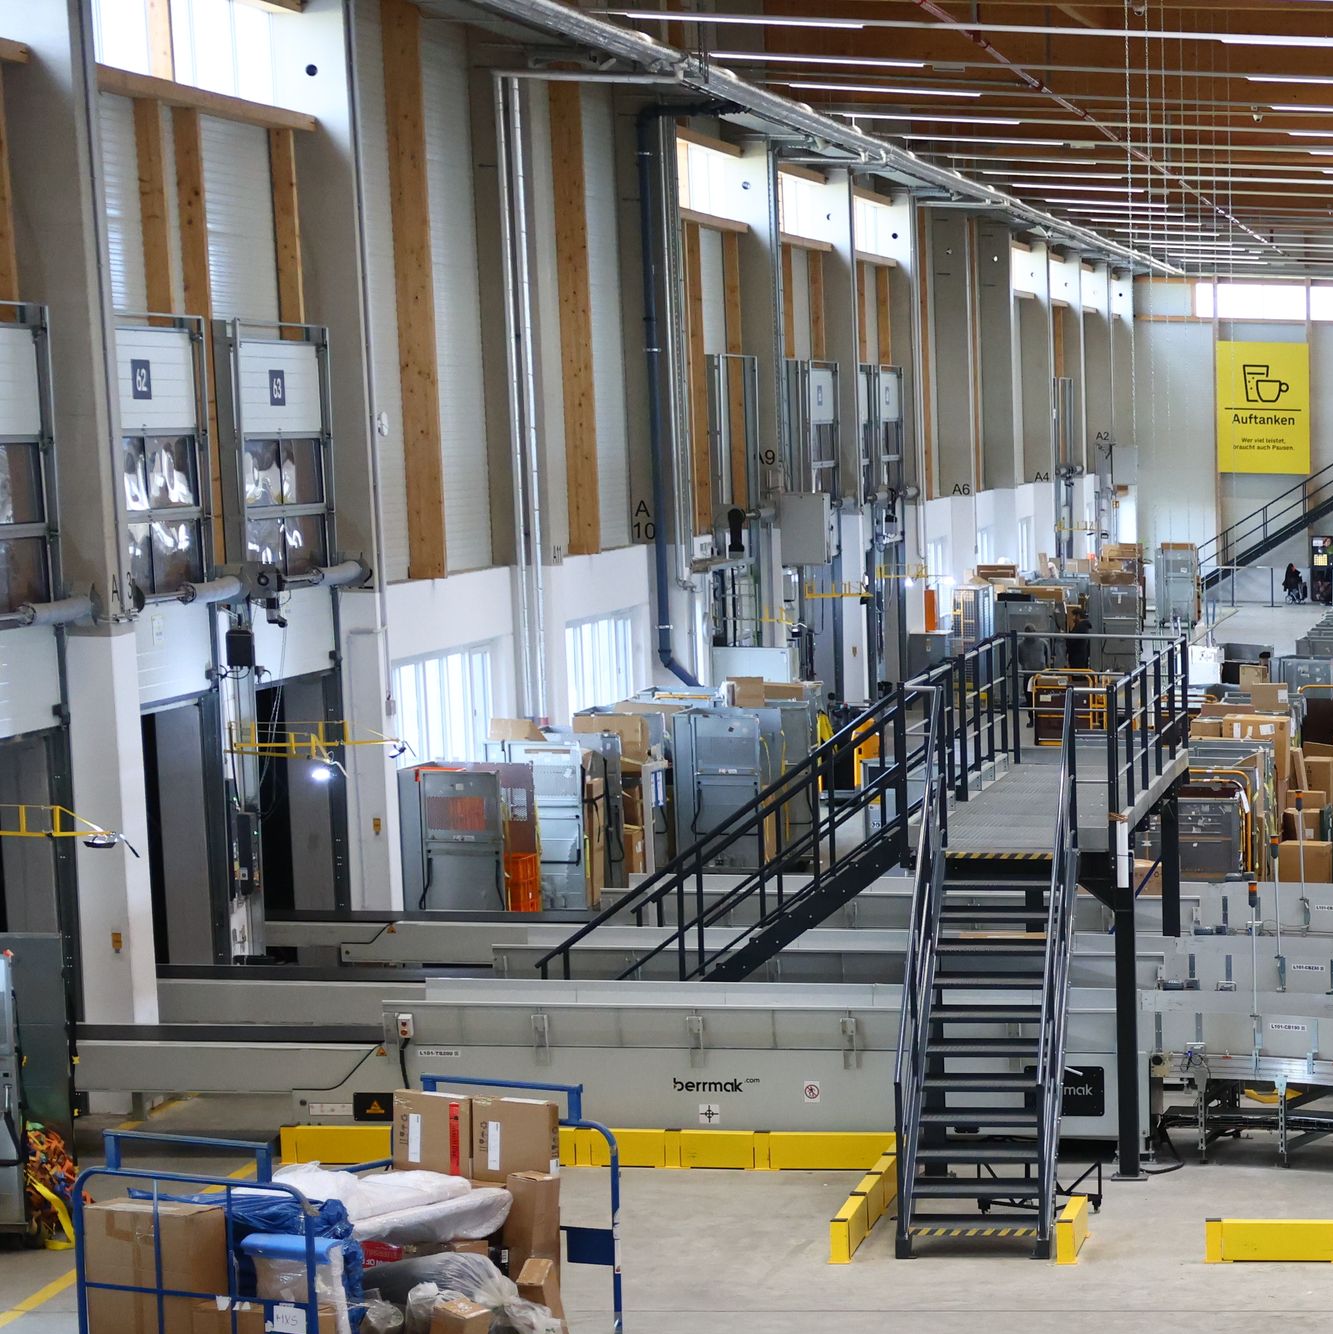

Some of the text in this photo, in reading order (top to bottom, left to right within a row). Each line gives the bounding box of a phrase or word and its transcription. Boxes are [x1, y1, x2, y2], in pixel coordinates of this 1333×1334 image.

[135, 368, 148, 392] 62
[272, 377, 283, 400] 63
[1232, 414, 1295, 425] Auftanken
[1096, 432, 1109, 441] A2
[1034, 471, 1049, 482] A4
[952, 483, 971, 496] A6
[635, 500, 650, 517] A
